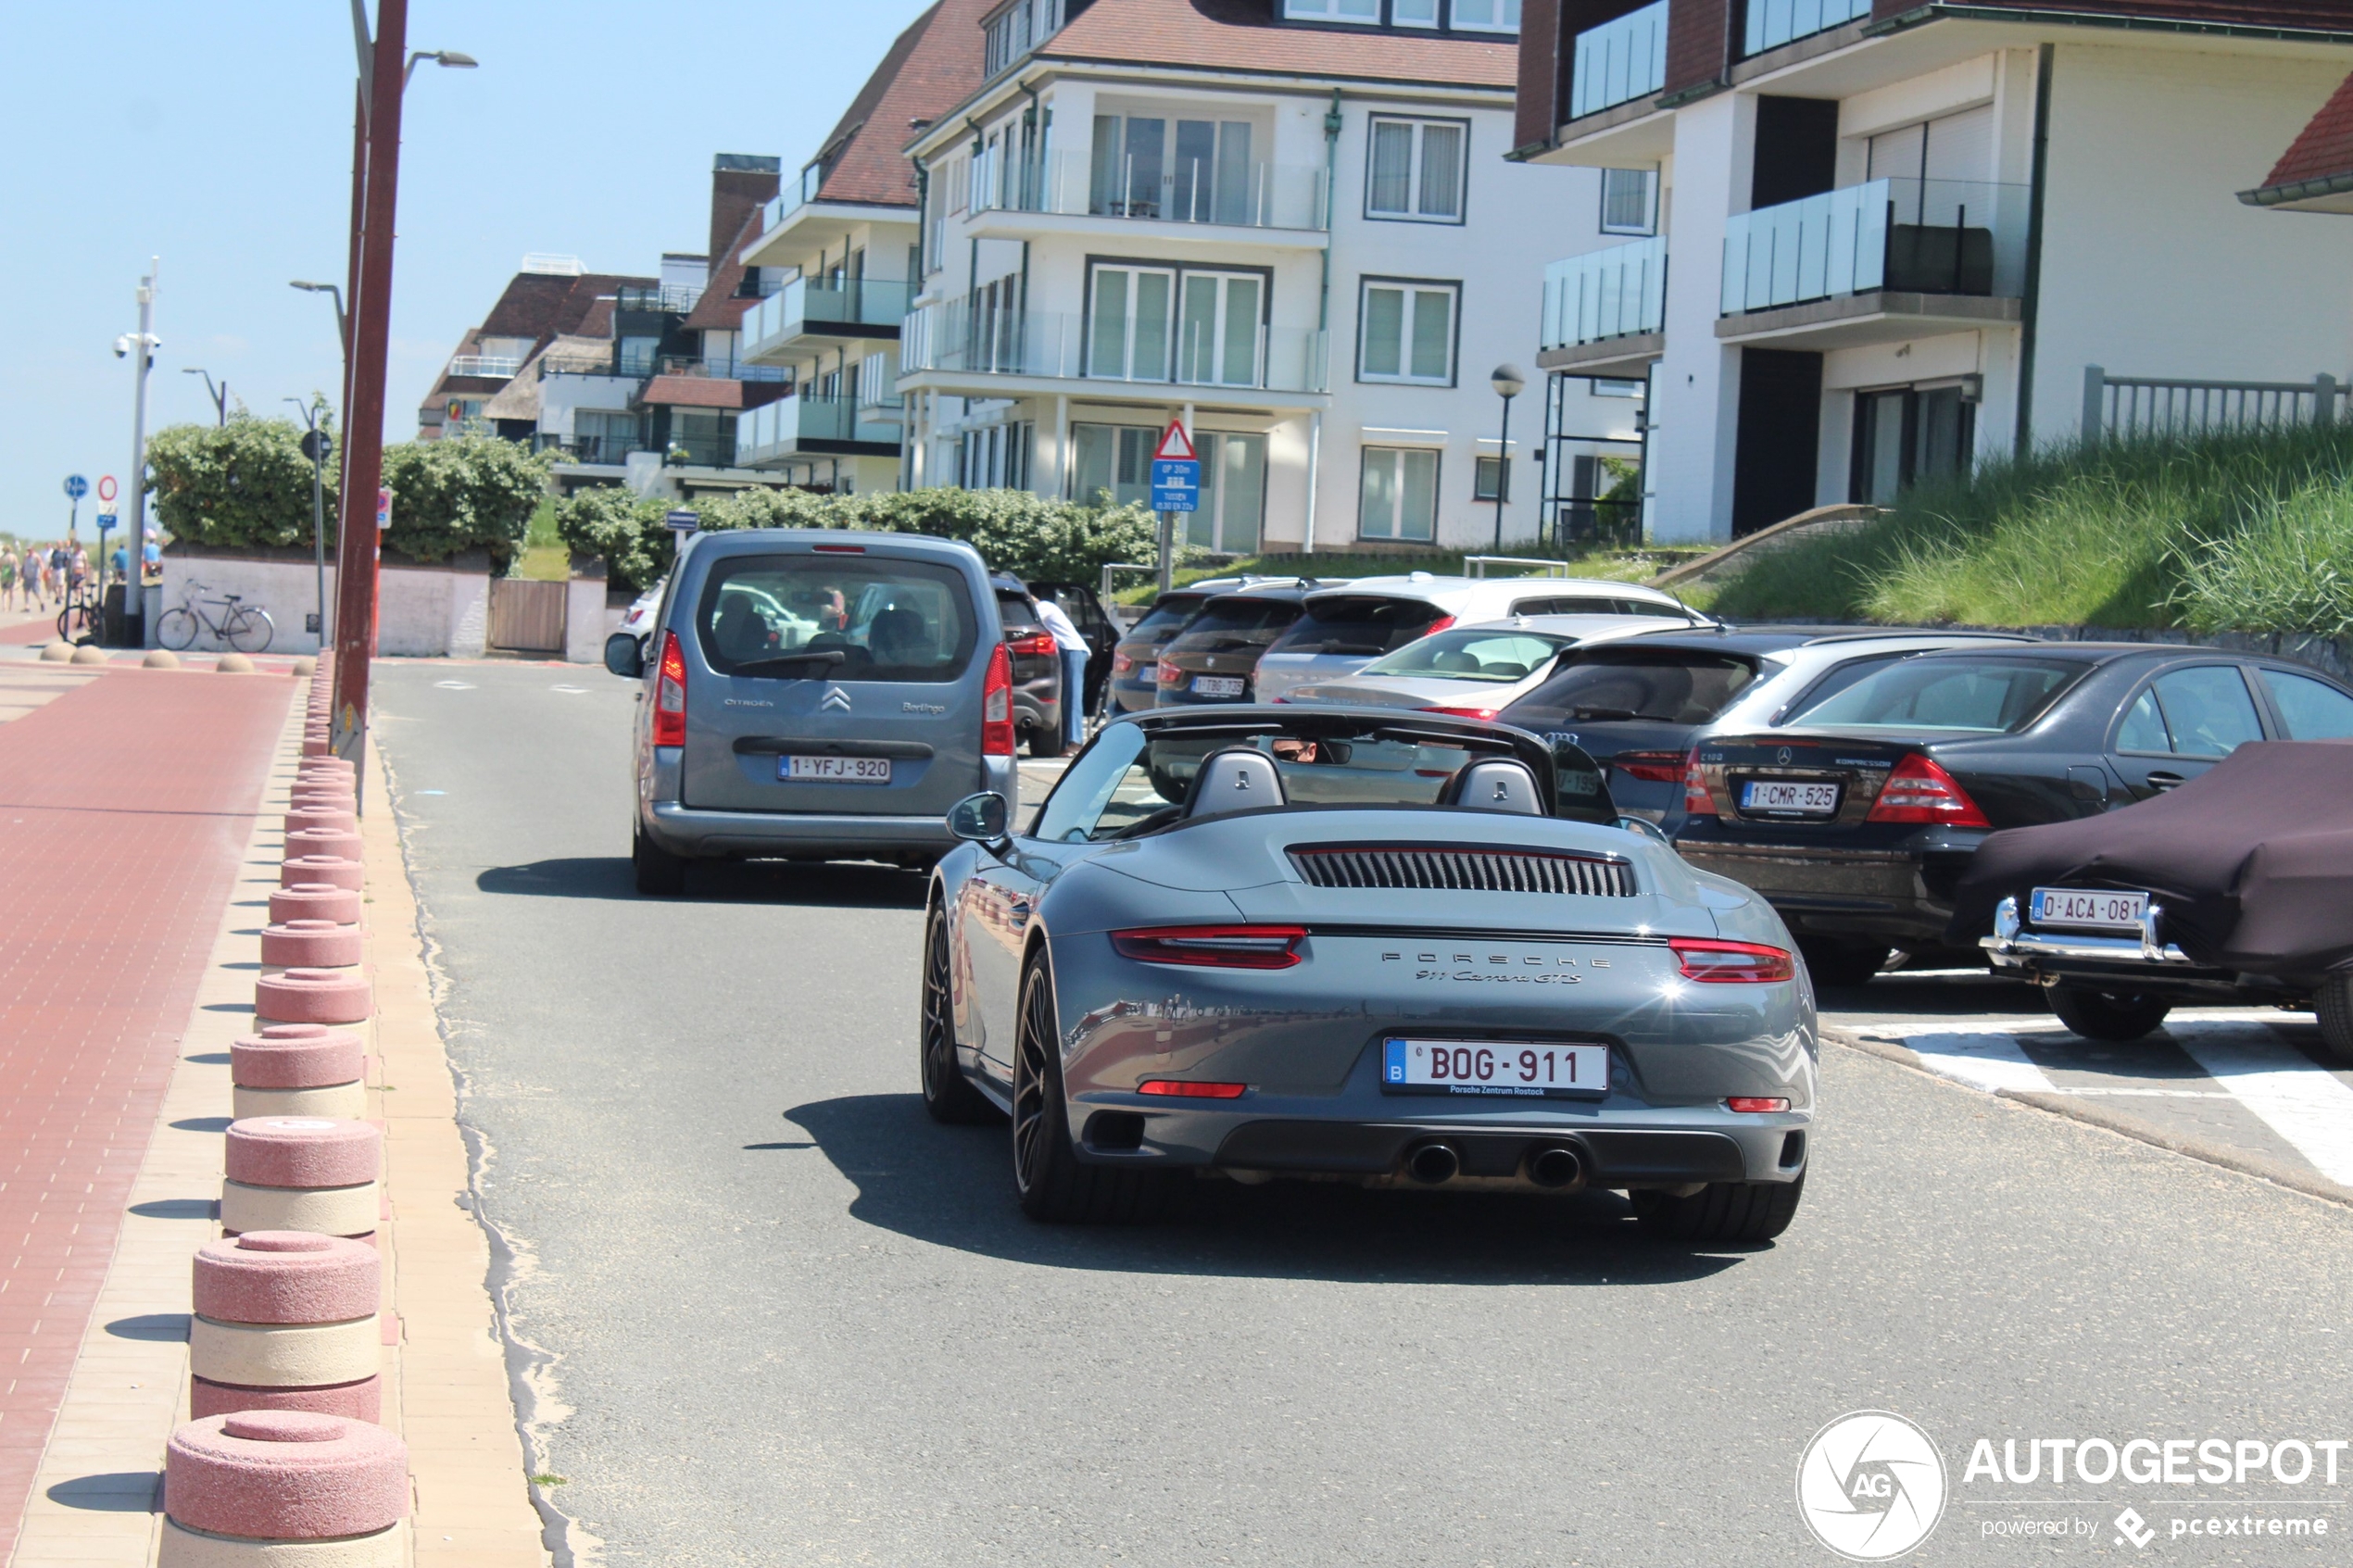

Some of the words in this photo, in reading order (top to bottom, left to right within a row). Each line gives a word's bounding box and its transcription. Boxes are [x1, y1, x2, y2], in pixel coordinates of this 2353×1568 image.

[1162, 464, 1172, 473] OP
[1174, 465, 1190, 474] 30m
[1164, 492, 1187, 501] TUSSEN
[902, 702, 945, 715] Berlingo
[793, 759, 888, 777] 1-YFJ-920
[1835, 758, 1892, 768] KOMPRESSOR
[1754, 786, 1834, 806] 1-CMR-525
[1381, 952, 1611, 968] PORSCHE
[1416, 971, 1450, 981] 911
[1453, 971, 1530, 983] Carrera
[1534, 973, 1582, 985] GTS
[1390, 1066, 1403, 1081] B
[1430, 1047, 1577, 1083] BOG-911
[1450, 1085, 1480, 1095] Porsche
[1481, 1086, 1513, 1095] Zentrum
[1514, 1086, 1544, 1096] Rostock
